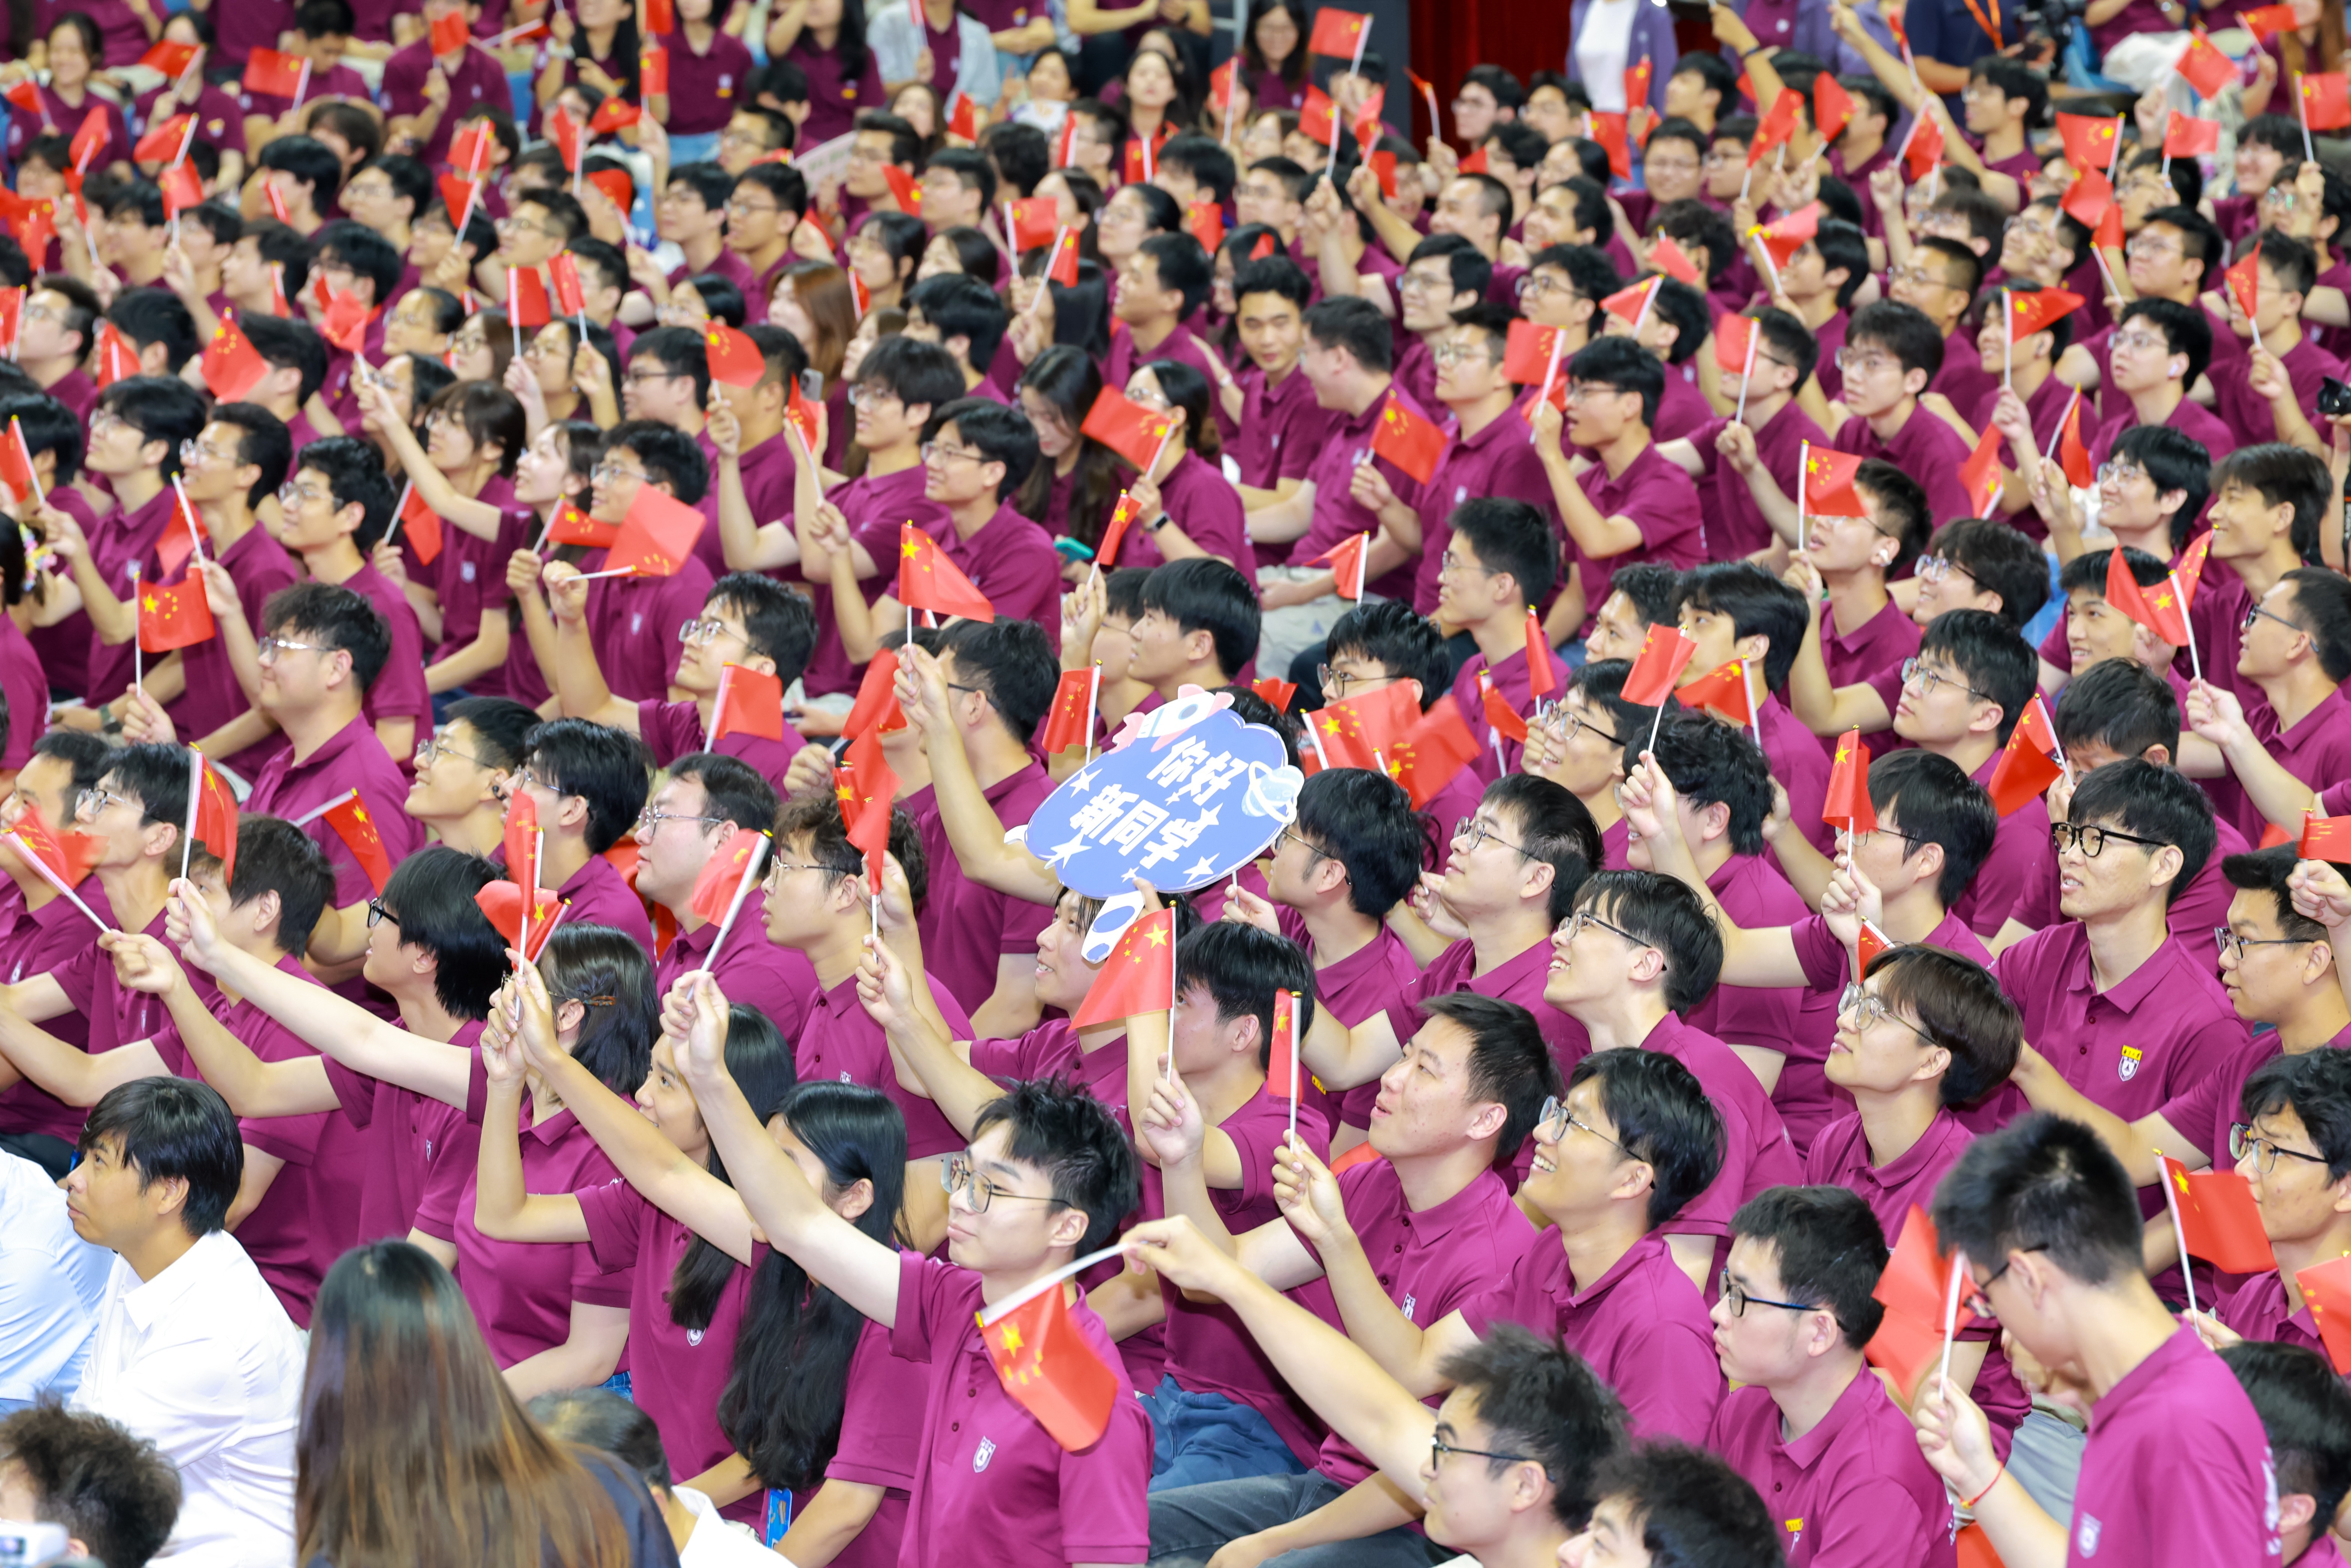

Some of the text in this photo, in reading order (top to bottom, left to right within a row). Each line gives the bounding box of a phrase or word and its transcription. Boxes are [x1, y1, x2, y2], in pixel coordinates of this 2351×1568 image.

[1146, 735, 1249, 806] 你好
[1069, 783, 1201, 870] 新同学
